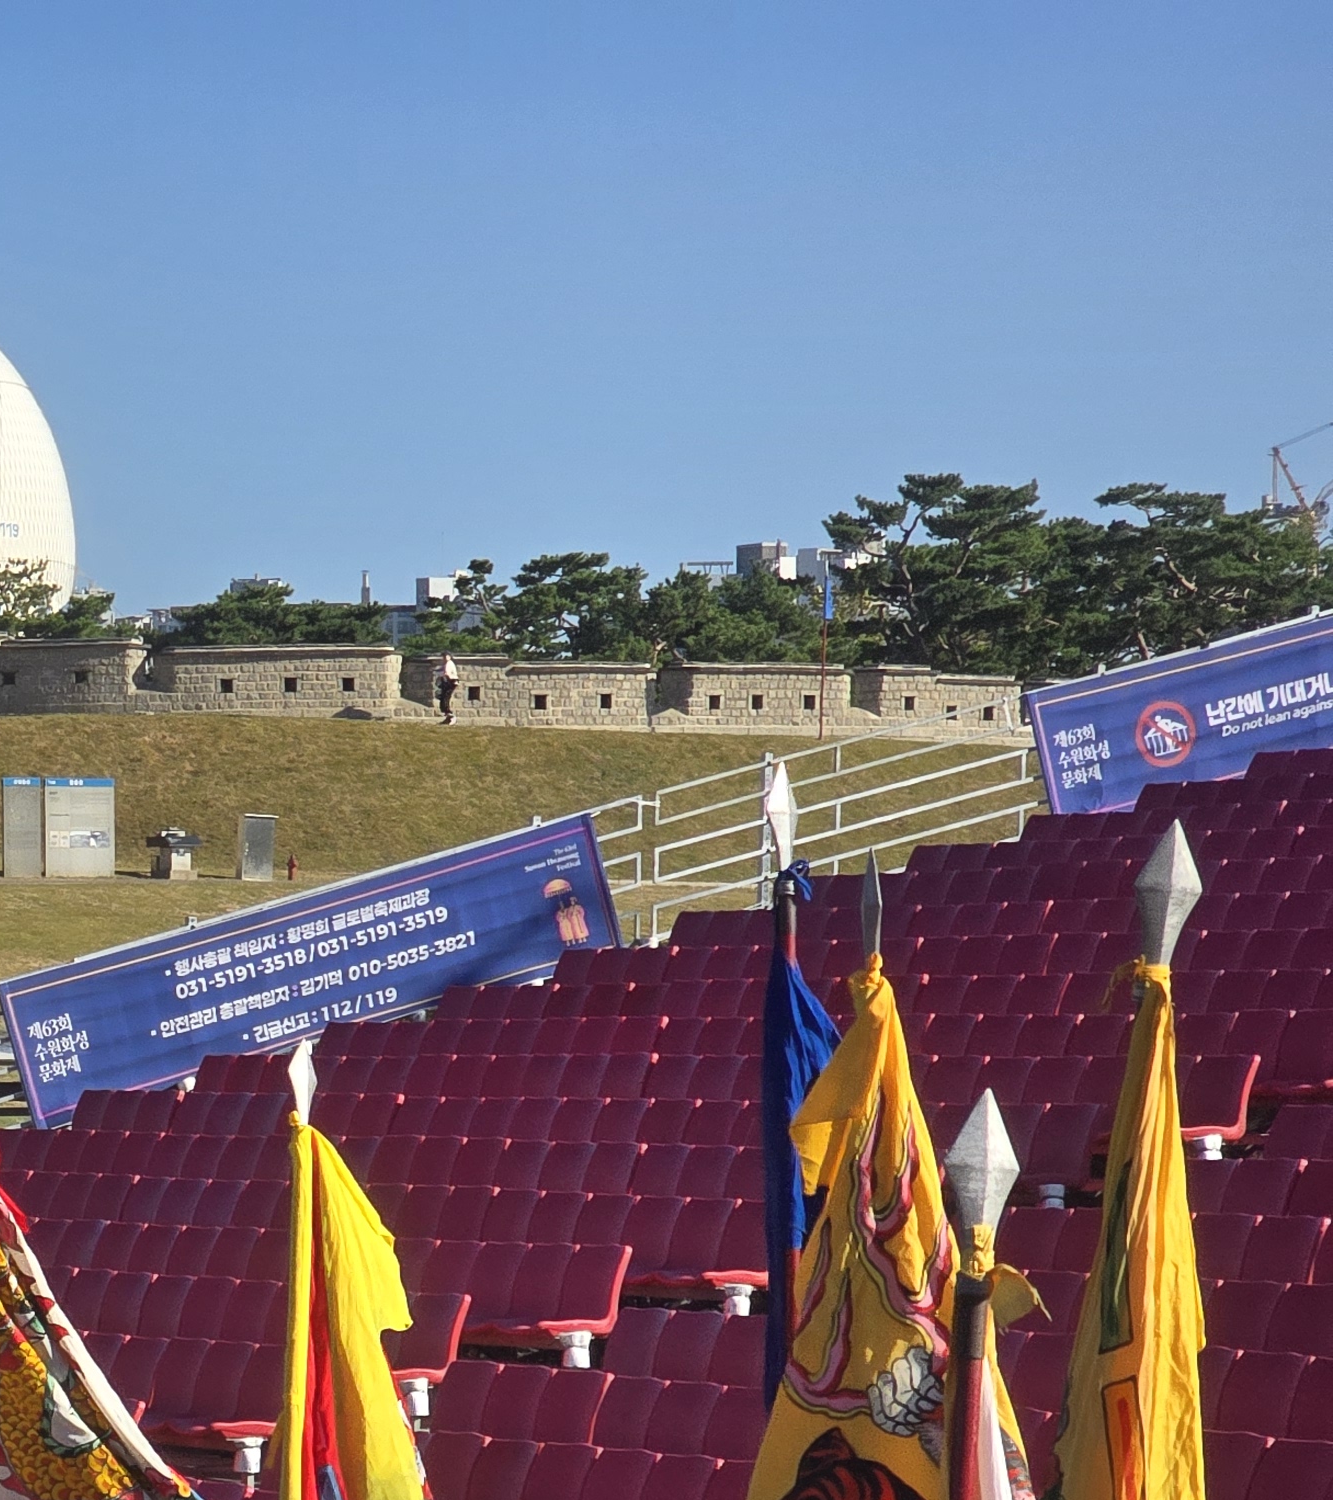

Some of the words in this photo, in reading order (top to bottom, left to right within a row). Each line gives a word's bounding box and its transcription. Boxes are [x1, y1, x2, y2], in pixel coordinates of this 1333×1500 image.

[1205, 690, 1265, 727] 난간에
[1053, 723, 1096, 748] 제63회
[1221, 725, 1240, 738] Do
[1241, 718, 1263, 732] not
[1264, 711, 1291, 726] lean
[1058, 739, 1111, 769] 수원화성
[1061, 763, 1103, 789] 문화제
[174, 947, 232, 977] 행사총괄
[331, 887, 431, 932] 글로벌축제과장
[160, 1007, 218, 1038] 안전관리
[348, 930, 476, 981] 010-5035-3821
[27, 1013, 73, 1040] 제63회
[34, 1030, 90, 1062] 수원화성
[39, 1054, 82, 1083] 문화제
